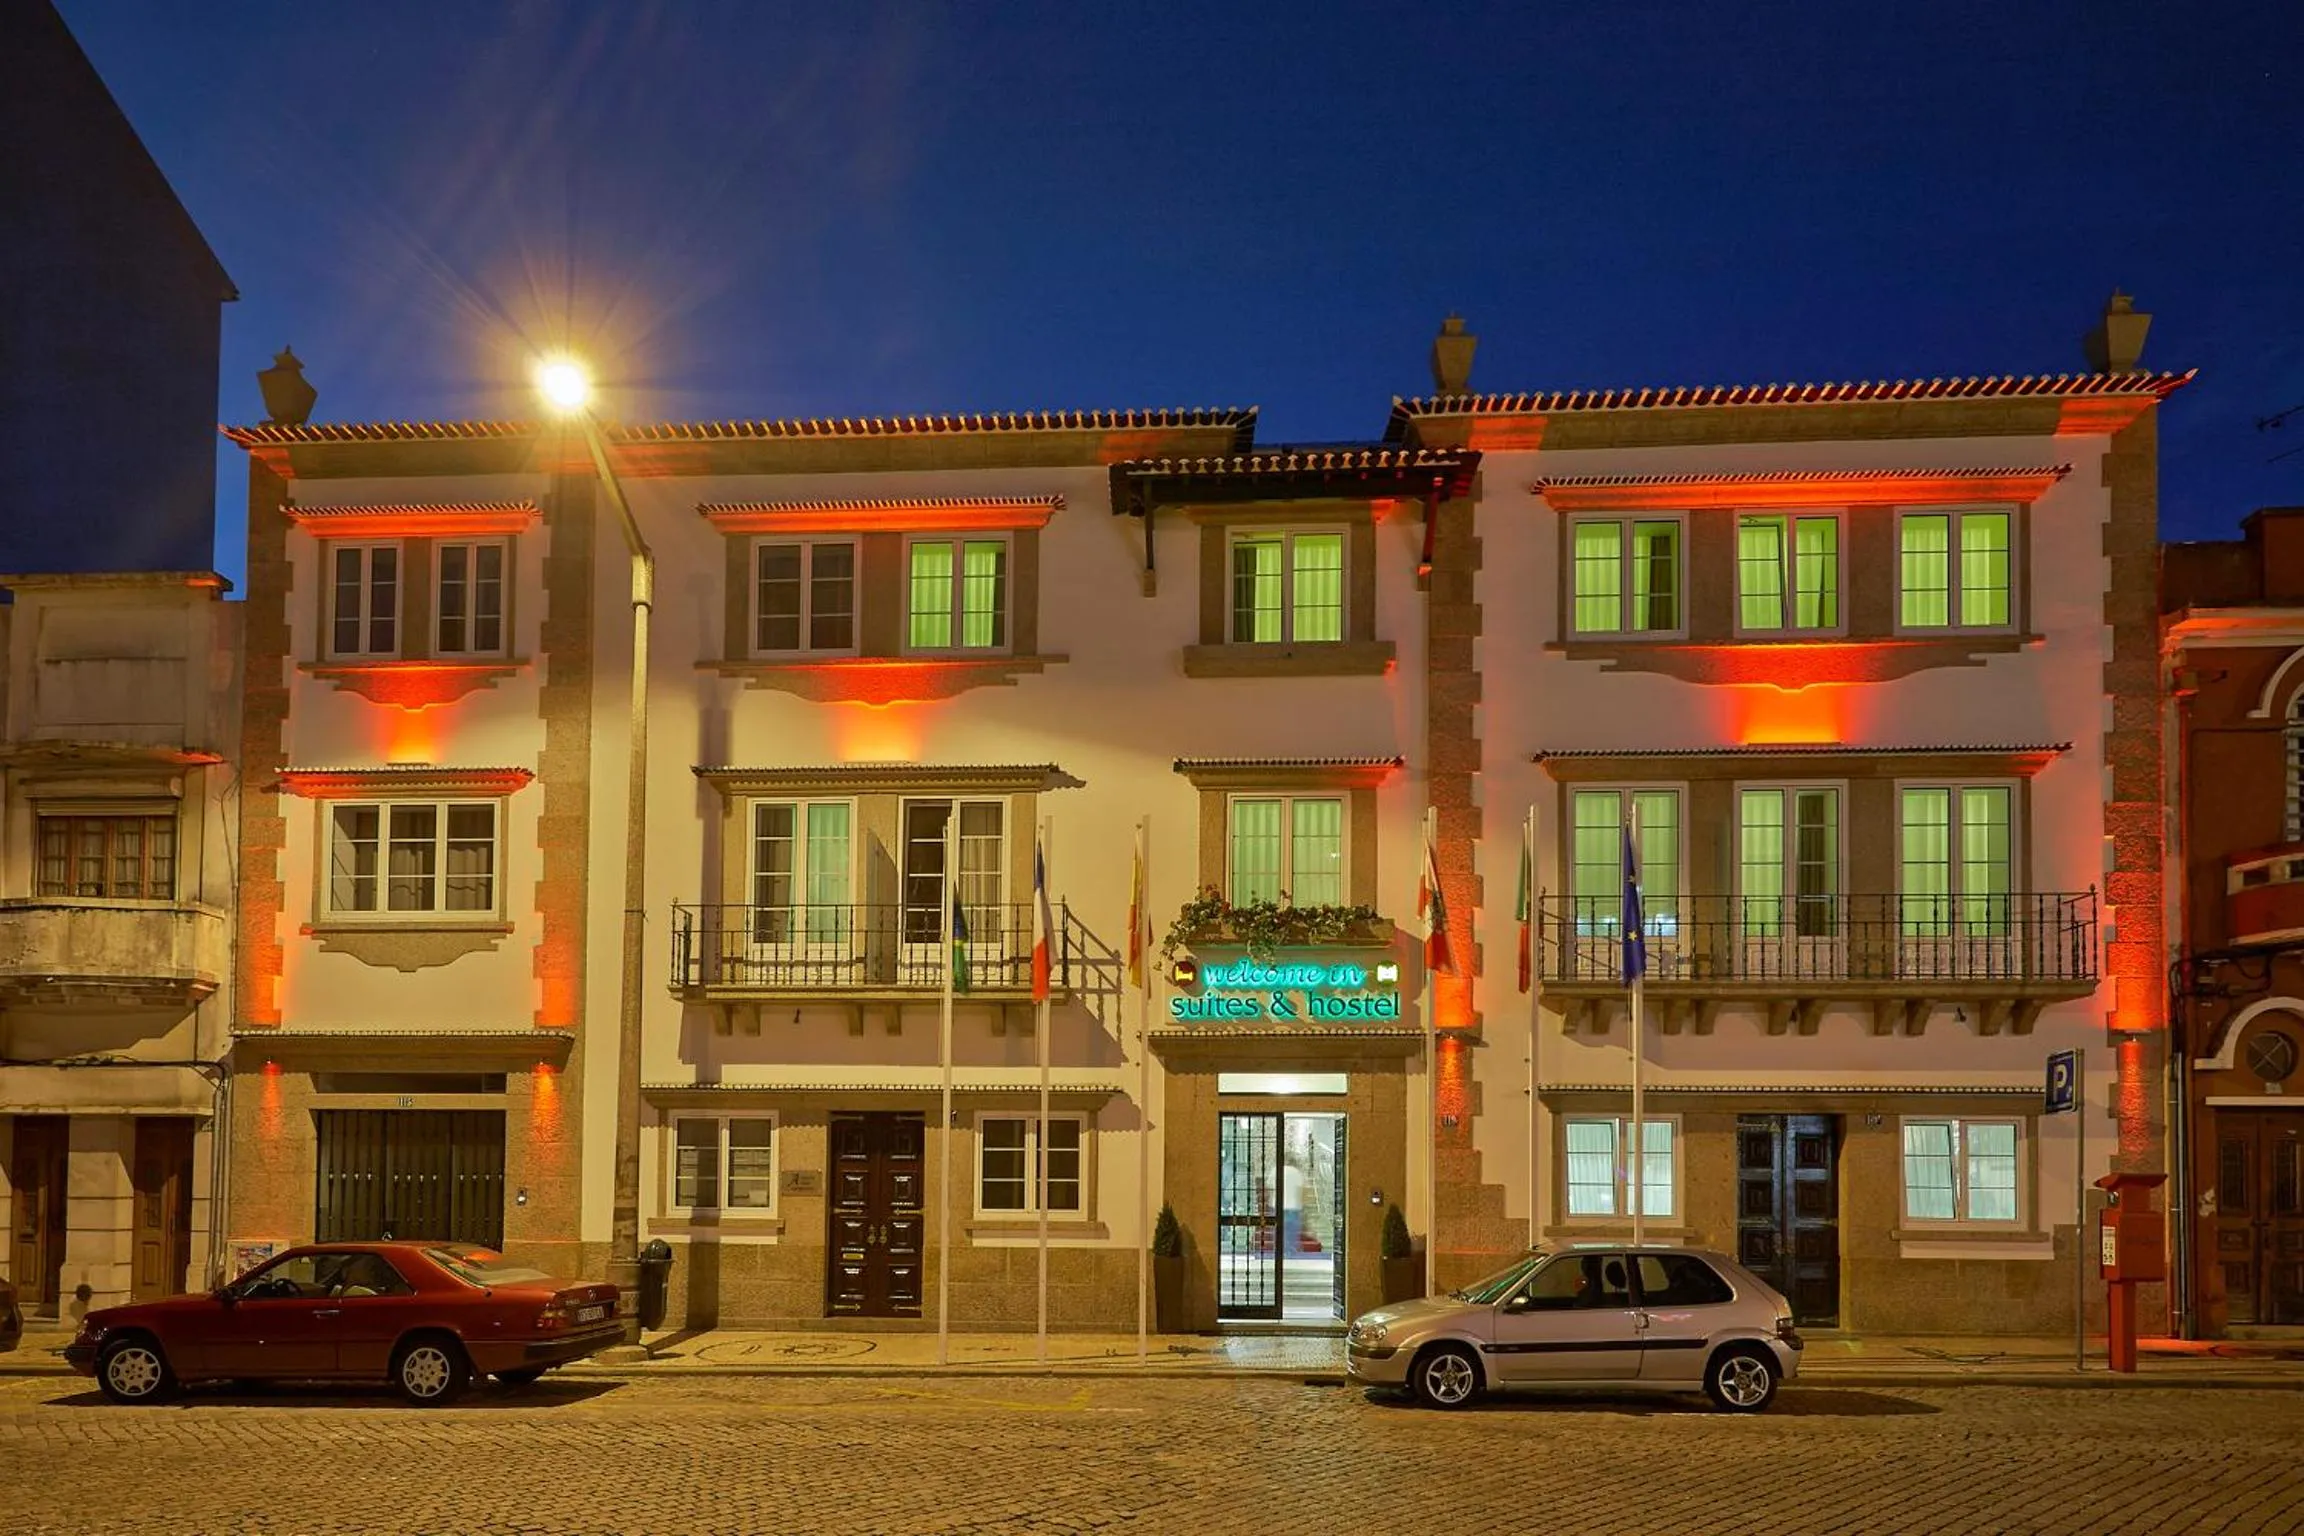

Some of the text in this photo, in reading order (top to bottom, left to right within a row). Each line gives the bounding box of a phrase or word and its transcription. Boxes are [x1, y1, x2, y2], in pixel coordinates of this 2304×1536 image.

[1207, 961, 1361, 984] welcome in
[1171, 991, 1400, 1017] suites & hostel
[2053, 1063, 2068, 1103] P
